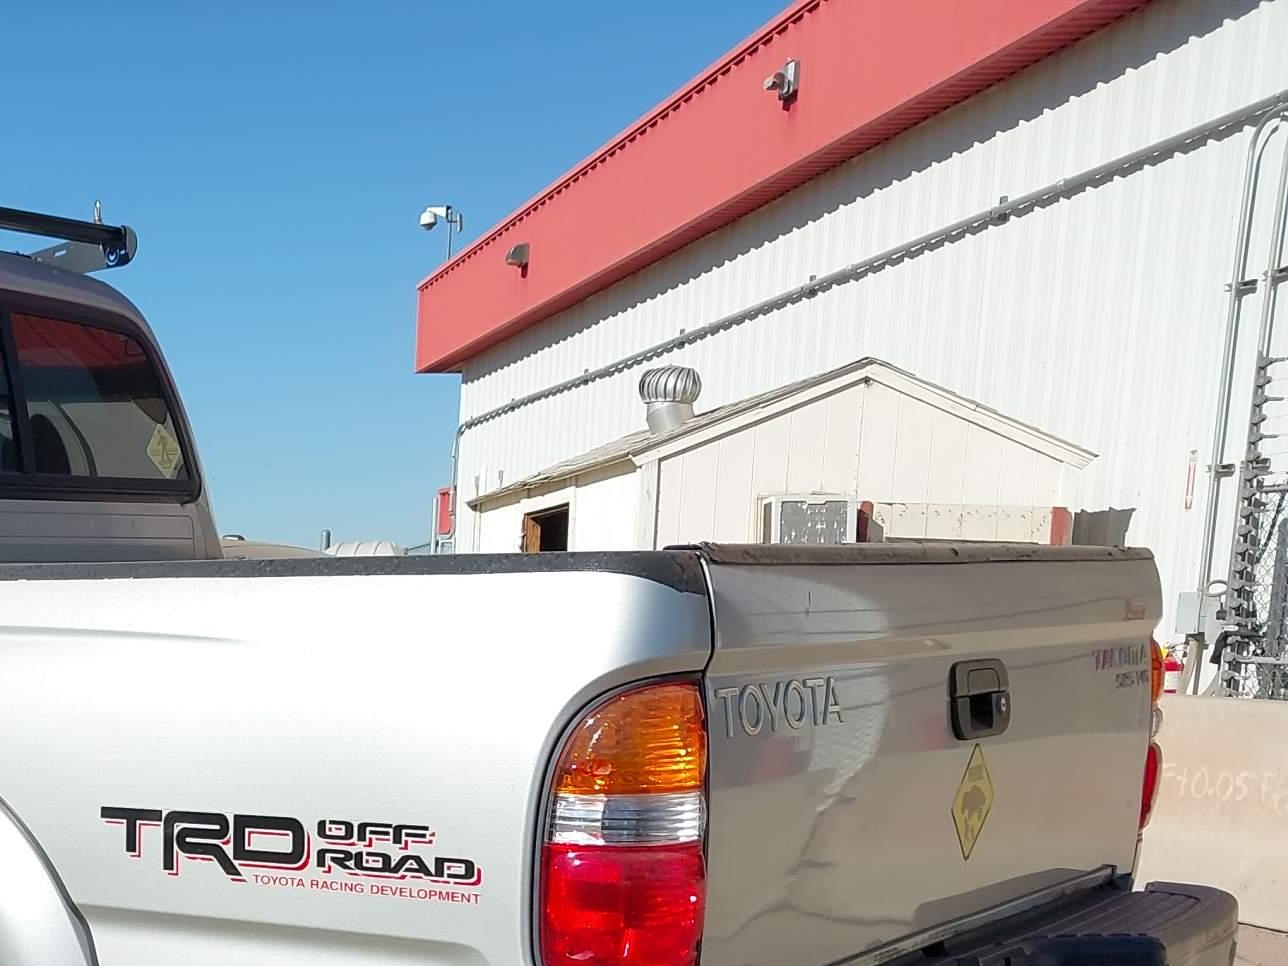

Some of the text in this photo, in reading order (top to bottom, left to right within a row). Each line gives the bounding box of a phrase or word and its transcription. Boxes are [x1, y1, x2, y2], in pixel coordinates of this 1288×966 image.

[714, 676, 845, 738] TOYOTA
[100, 806, 436, 883] TRD OFF
[316, 848, 483, 886] ROAD
[252, 873, 482, 905] TOYOTA RACING DEVELOPMENT
